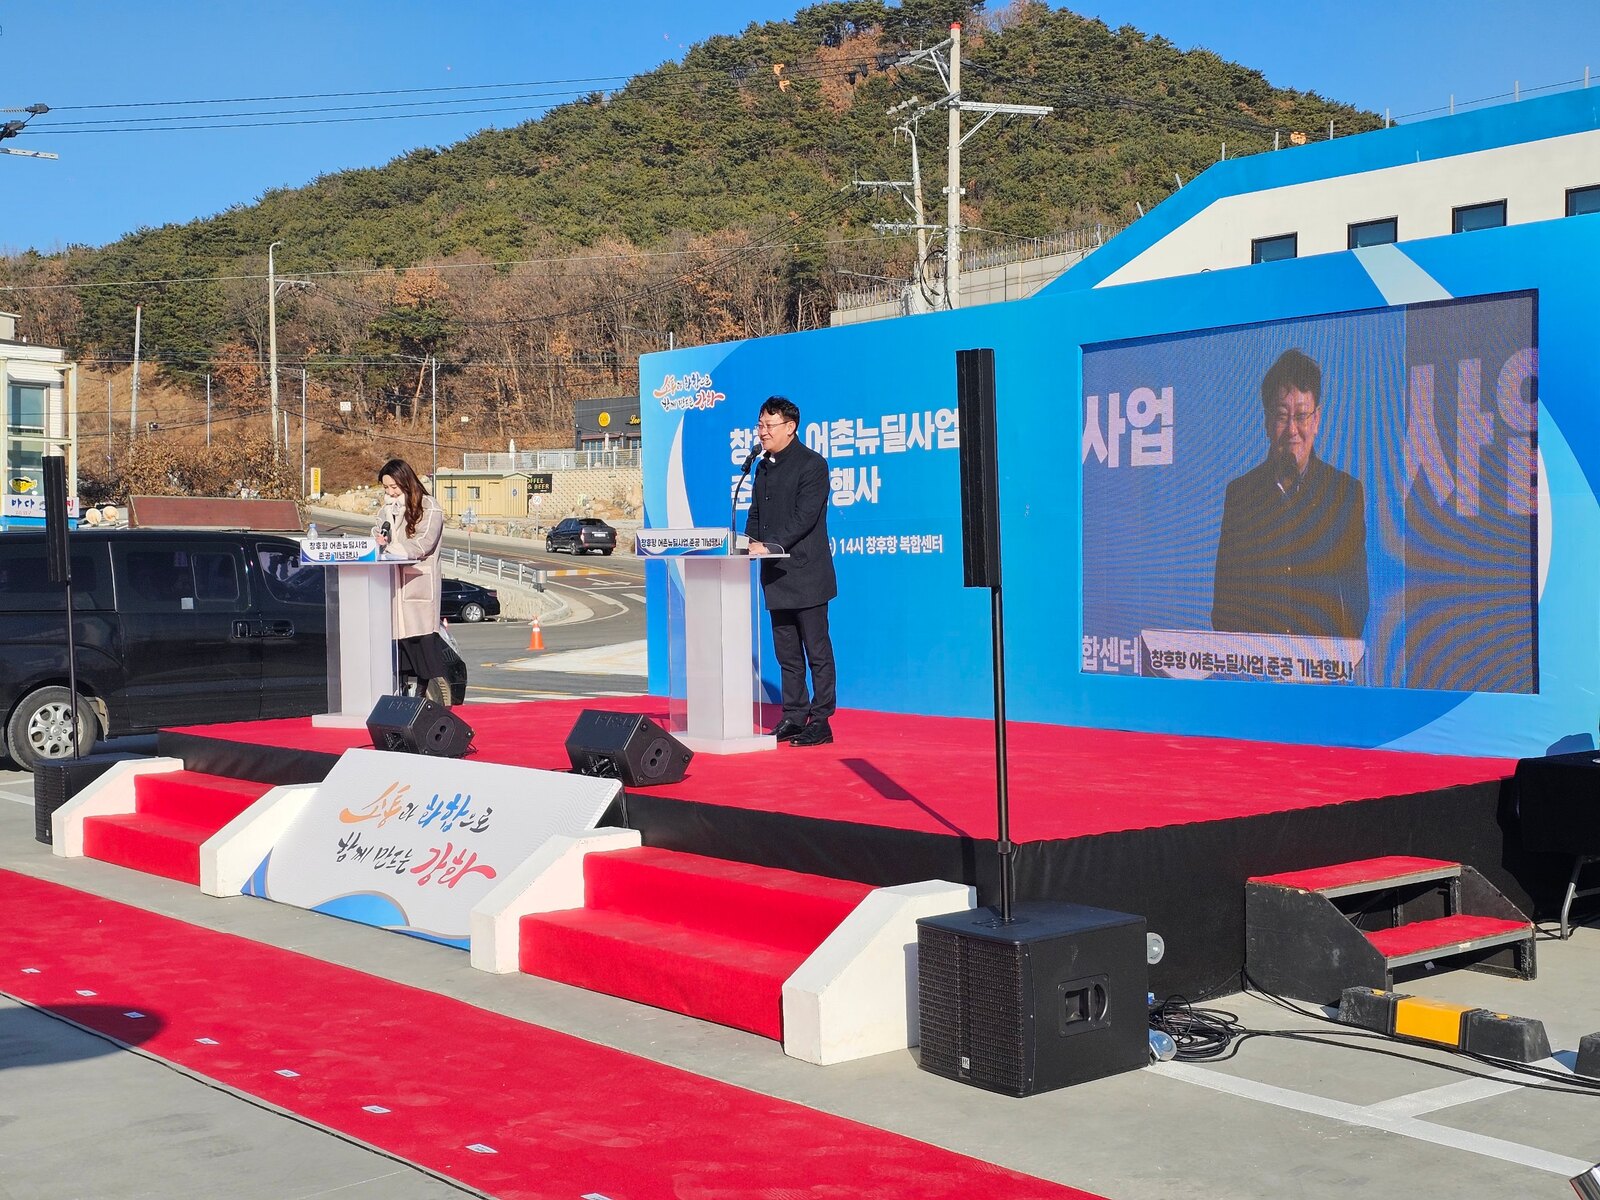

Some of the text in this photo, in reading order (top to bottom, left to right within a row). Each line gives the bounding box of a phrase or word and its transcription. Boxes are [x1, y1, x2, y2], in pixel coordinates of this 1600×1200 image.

[805, 408, 961, 459] 어촌뉴딜사업
[1082, 386, 1174, 468] 사업
[309, 540, 368, 550] 창후항 어촌뉴딜사업
[641, 538, 657, 548] 창후항
[658, 538, 689, 548] 어촌뉴딜사업
[840, 536, 864, 554] 14시
[866, 535, 897, 554] 창후항
[899, 534, 943, 554] 복합센터
[1151, 649, 1353, 681] 창후항 어촌뉴딜사업 준공 기념행사
